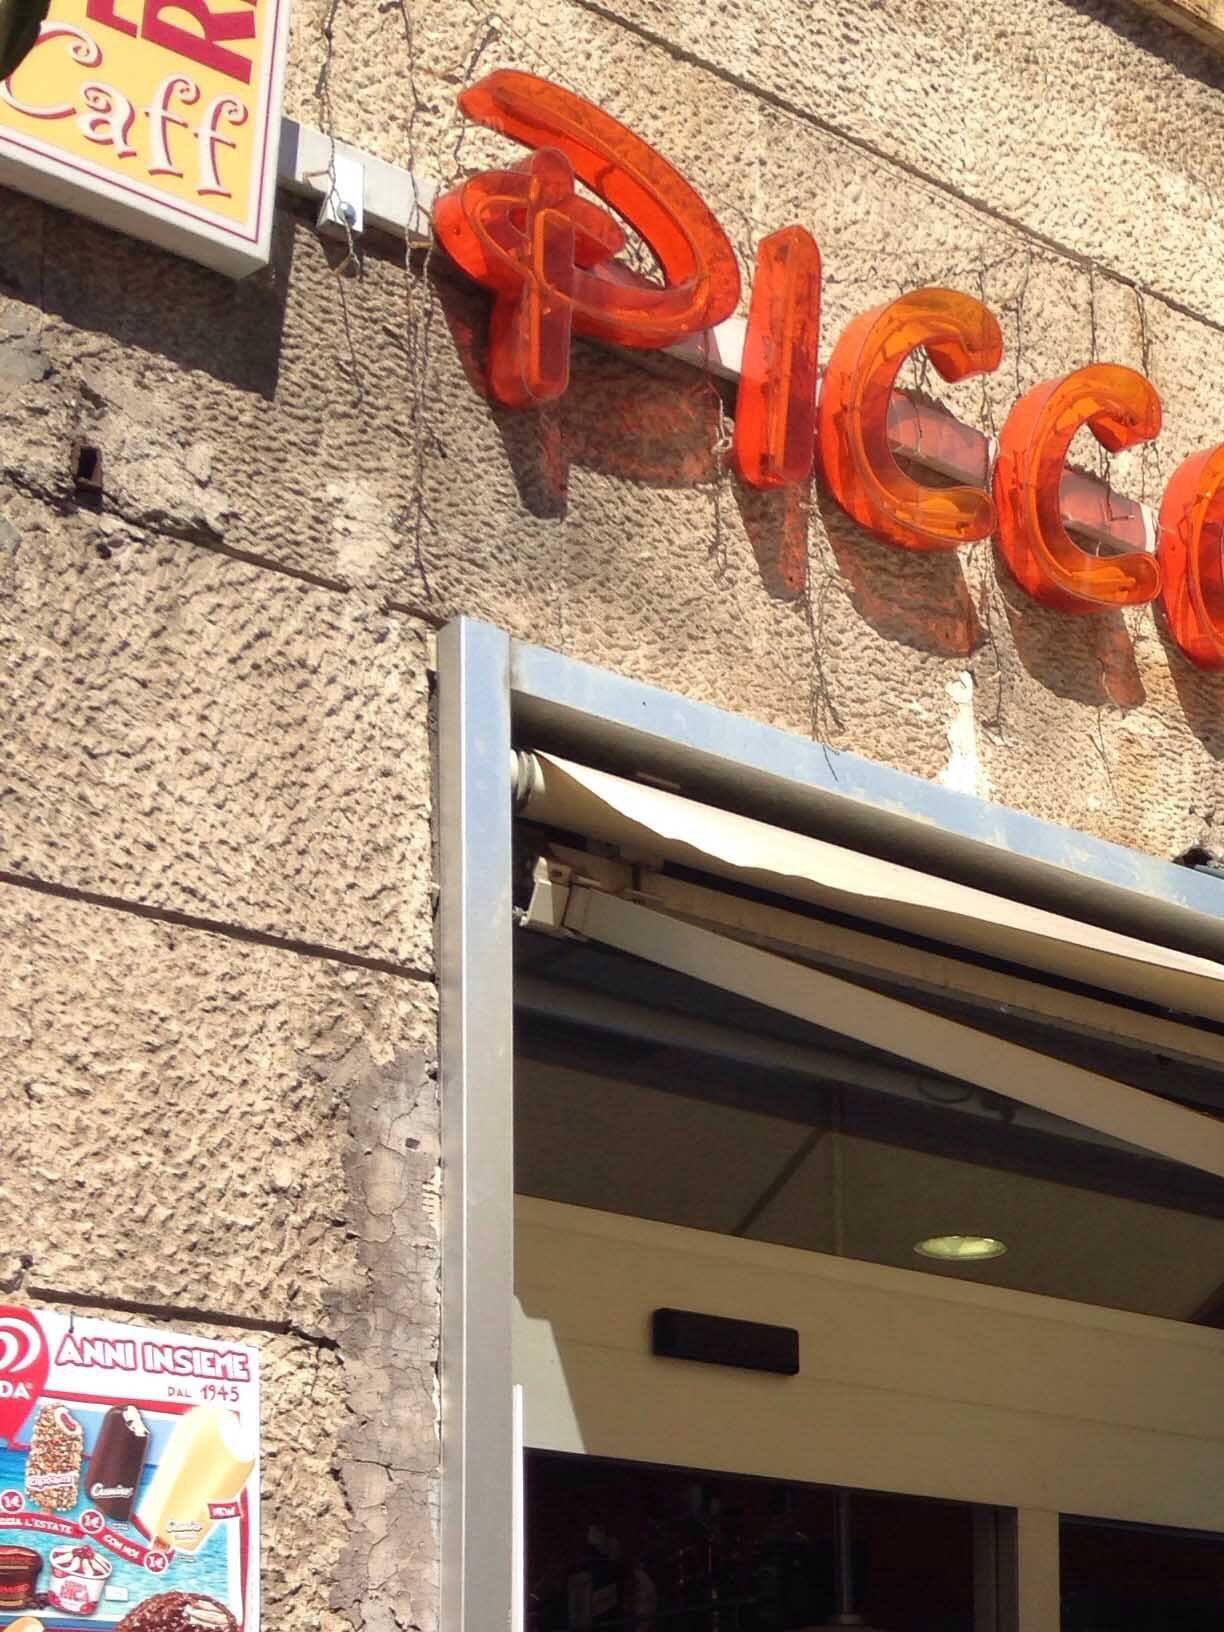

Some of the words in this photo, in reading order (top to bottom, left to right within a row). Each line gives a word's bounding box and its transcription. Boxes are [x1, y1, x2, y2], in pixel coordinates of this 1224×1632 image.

[56, 1332, 136, 1370] ANNI
[142, 1342, 250, 1382] INSIEME
[168, 1386, 191, 1398] DAL
[200, 1384, 240, 1401] 1945
